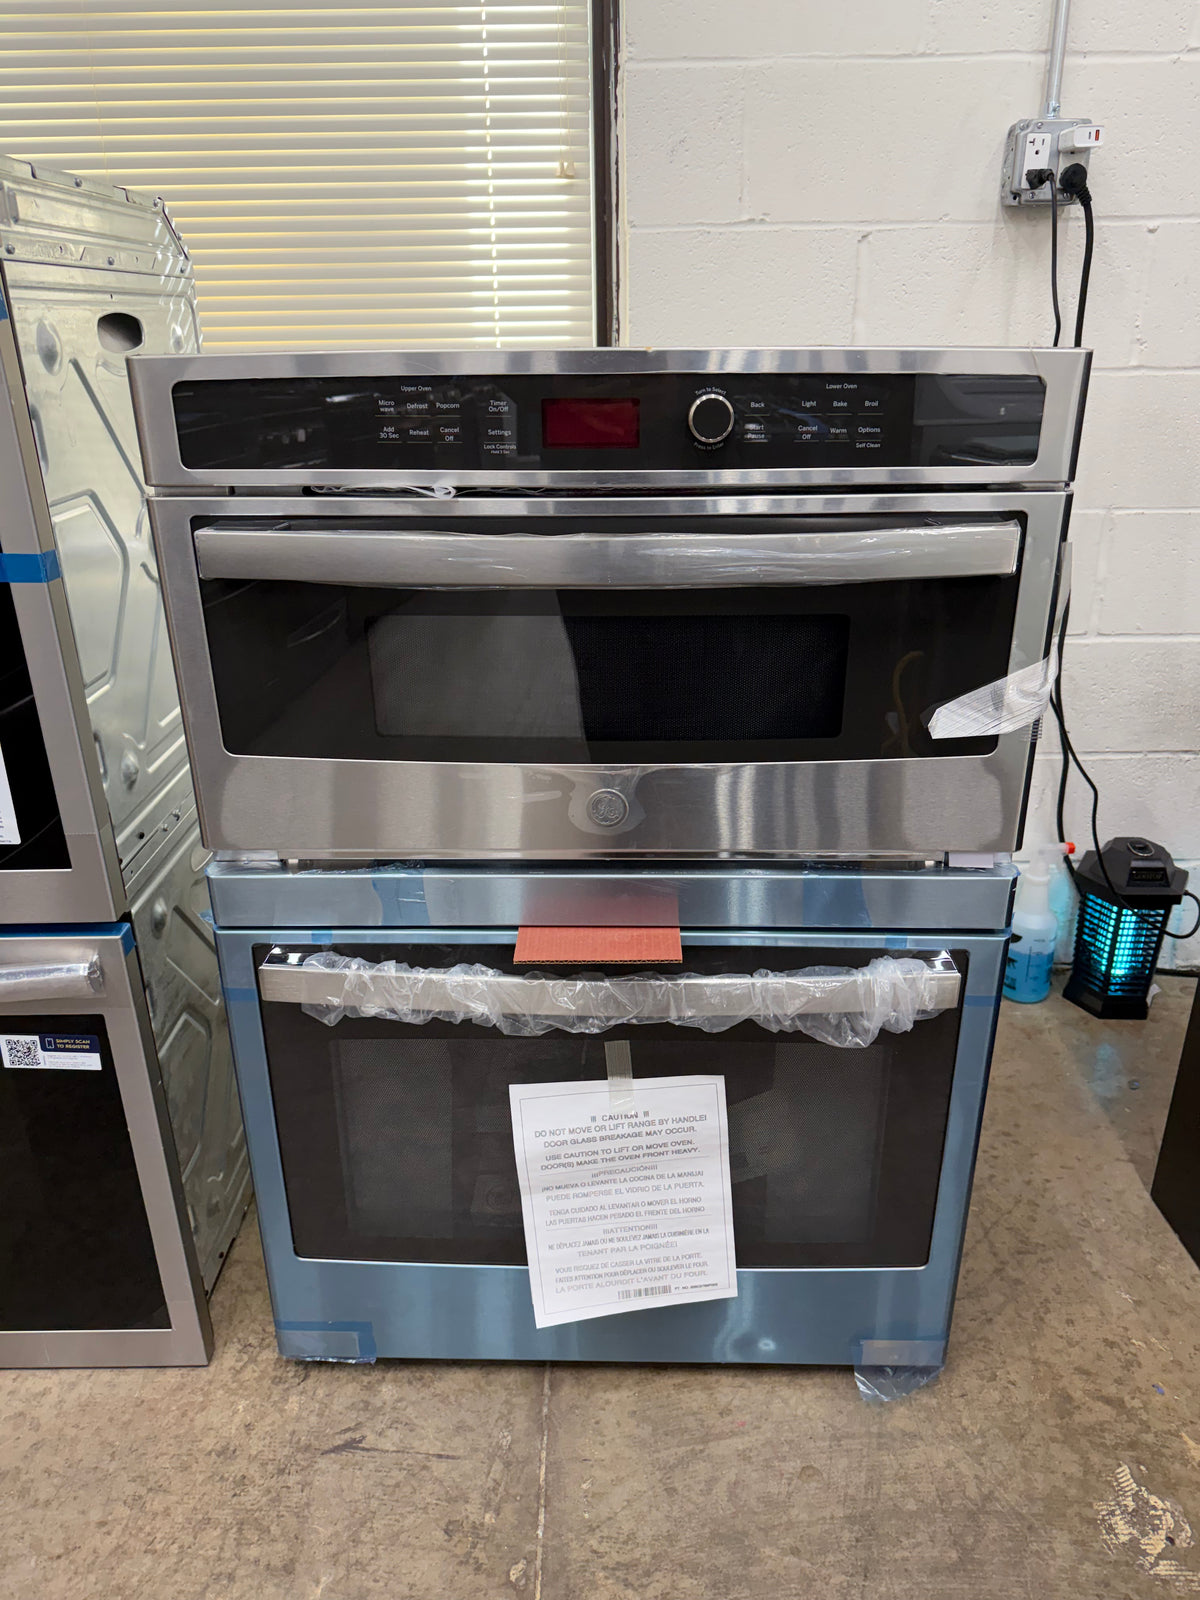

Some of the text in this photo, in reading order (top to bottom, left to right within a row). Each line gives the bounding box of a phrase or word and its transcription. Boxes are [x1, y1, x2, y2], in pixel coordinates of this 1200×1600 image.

[712, 387, 726, 396] Select
[436, 402, 460, 410] Popcorn
[858, 426, 881, 434] Options
[535, 1130, 547, 1138] DO
[549, 1128, 567, 1136] NOT
[569, 1126, 592, 1135] MOVE
[608, 1123, 625, 1131] LIFT
[628, 1120, 656, 1129] RANGE
[544, 1126, 697, 1148] DOOR GLASS BREAKAGE MAY OCCUR.
[541, 1162, 574, 1171] DOOR(S)
[576, 1158, 598, 1167] MAKE
[618, 1153, 640, 1161] OVEN
[643, 1150, 668, 1159] FRONT
[671, 1147, 700, 1156] HEAVY.
[546, 1153, 561, 1161] USE
[564, 1150, 598, 1159] CAUTION
[614, 1146, 630, 1154] LIFT
[646, 1142, 668, 1150] MOVE
[671, 1139, 695, 1147] OVEN.
[588, 1178, 617, 1187] LEVANTE
[629, 1174, 654, 1182] COCINA
[546, 1193, 571, 1202] PUEDE
[573, 1188, 613, 1199] ROMPERSE
[626, 1185, 650, 1194] VIDRIO
[652, 1184, 662, 1192] DE
[549, 1208, 569, 1217] TENGA
[571, 1205, 598, 1214] CUIDADO
[608, 1200, 639, 1210] LEVANTAR
[647, 1198, 669, 1206] MOVER
[679, 1196, 701, 1204] HORNO
[559, 1216, 586, 1225] PUERTAS
[588, 1214, 608, 1222] HACEN
[610, 1211, 634, 1220] PESADO
[644, 1208, 668, 1216] FRENTE
[683, 1205, 704, 1213] HORNO
[578, 1248, 609, 1257] TENANT
[555, 1266, 572, 1274] VOUS
[574, 1263, 599, 1271] RISQUEZ
[611, 1260, 634, 1268] CASSER
[556, 1286, 566, 1294] LA
[568, 1283, 593, 1292] PORTE
[596, 1278, 635, 1289] ALOURDIT
[637, 1273, 668, 1284] L'AVANT
[671, 1271, 682, 1279] DU
[574, 1273, 603, 1282] ATTENTION
